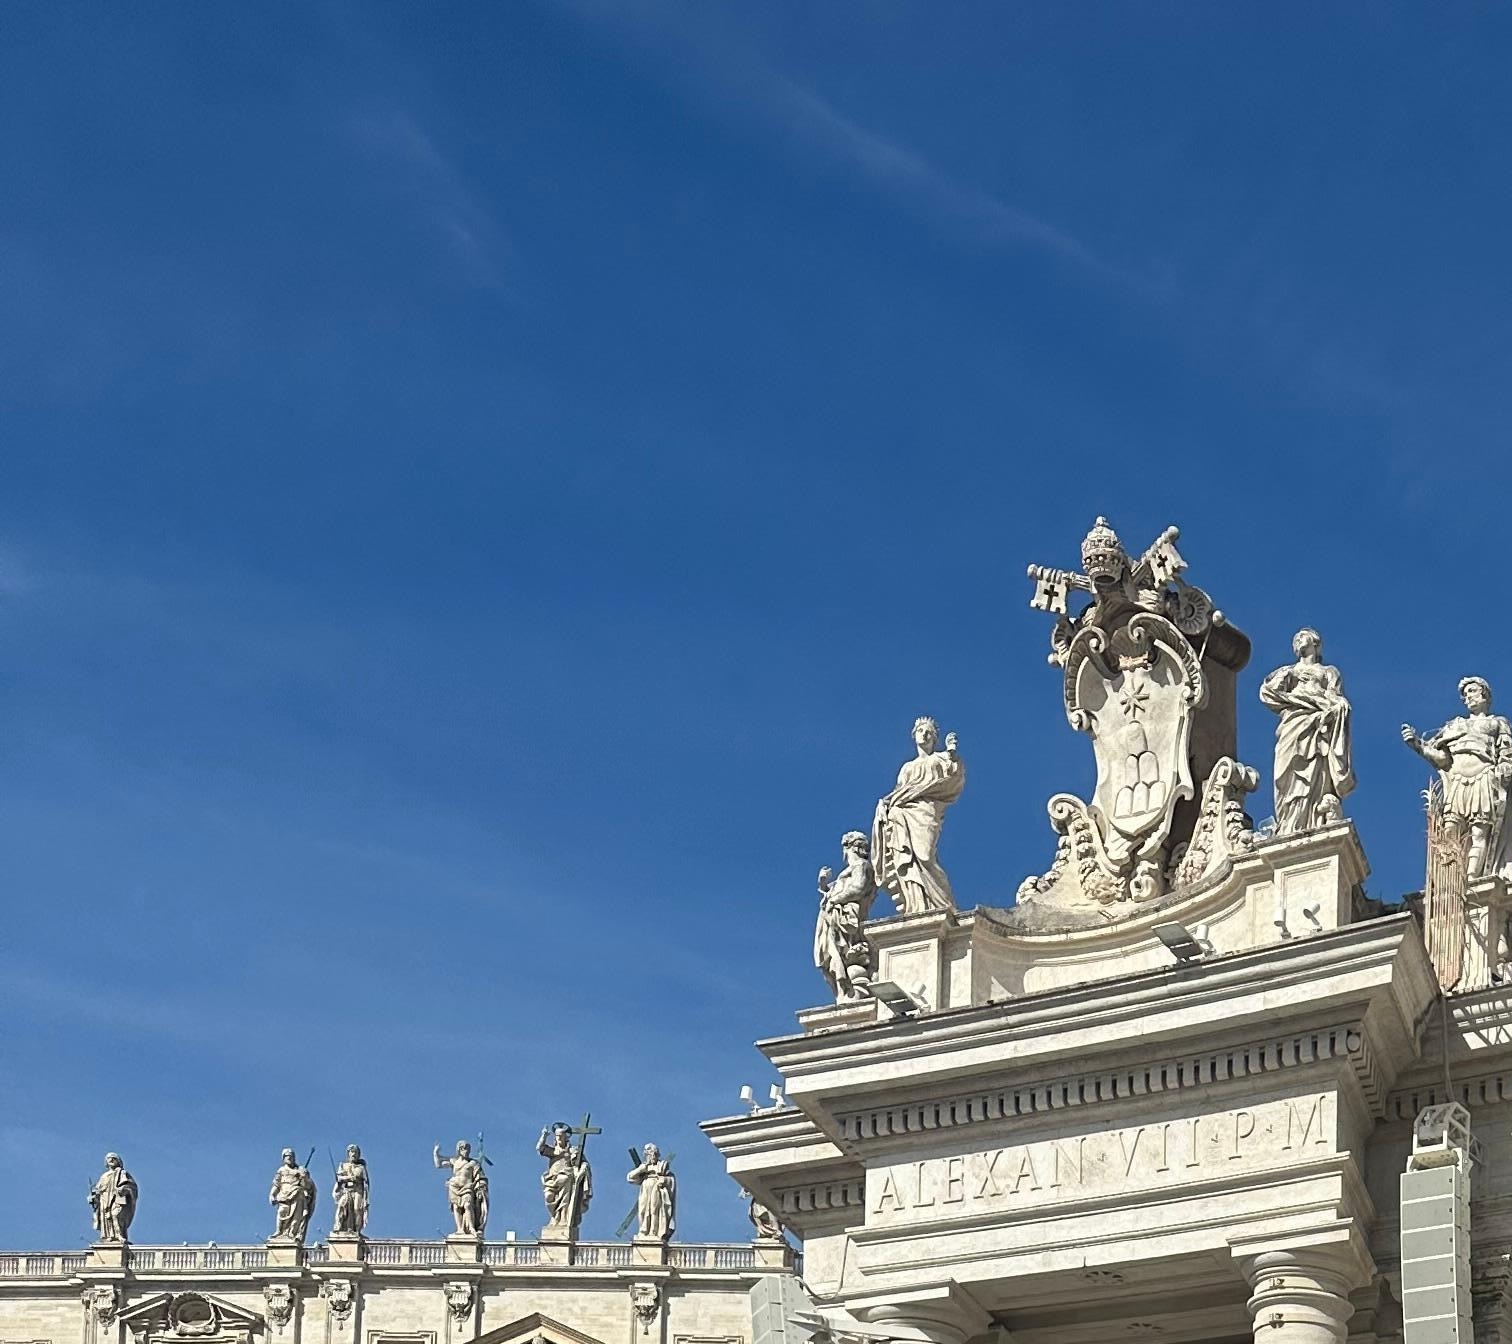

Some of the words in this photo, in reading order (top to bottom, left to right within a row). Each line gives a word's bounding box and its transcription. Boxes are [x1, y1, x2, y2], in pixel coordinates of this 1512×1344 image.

[872, 1137, 1088, 1214] ALEXAN
[1117, 1119, 1201, 1178] VII
[1229, 1110, 1256, 1161] P
[1281, 1094, 1329, 1151] M
